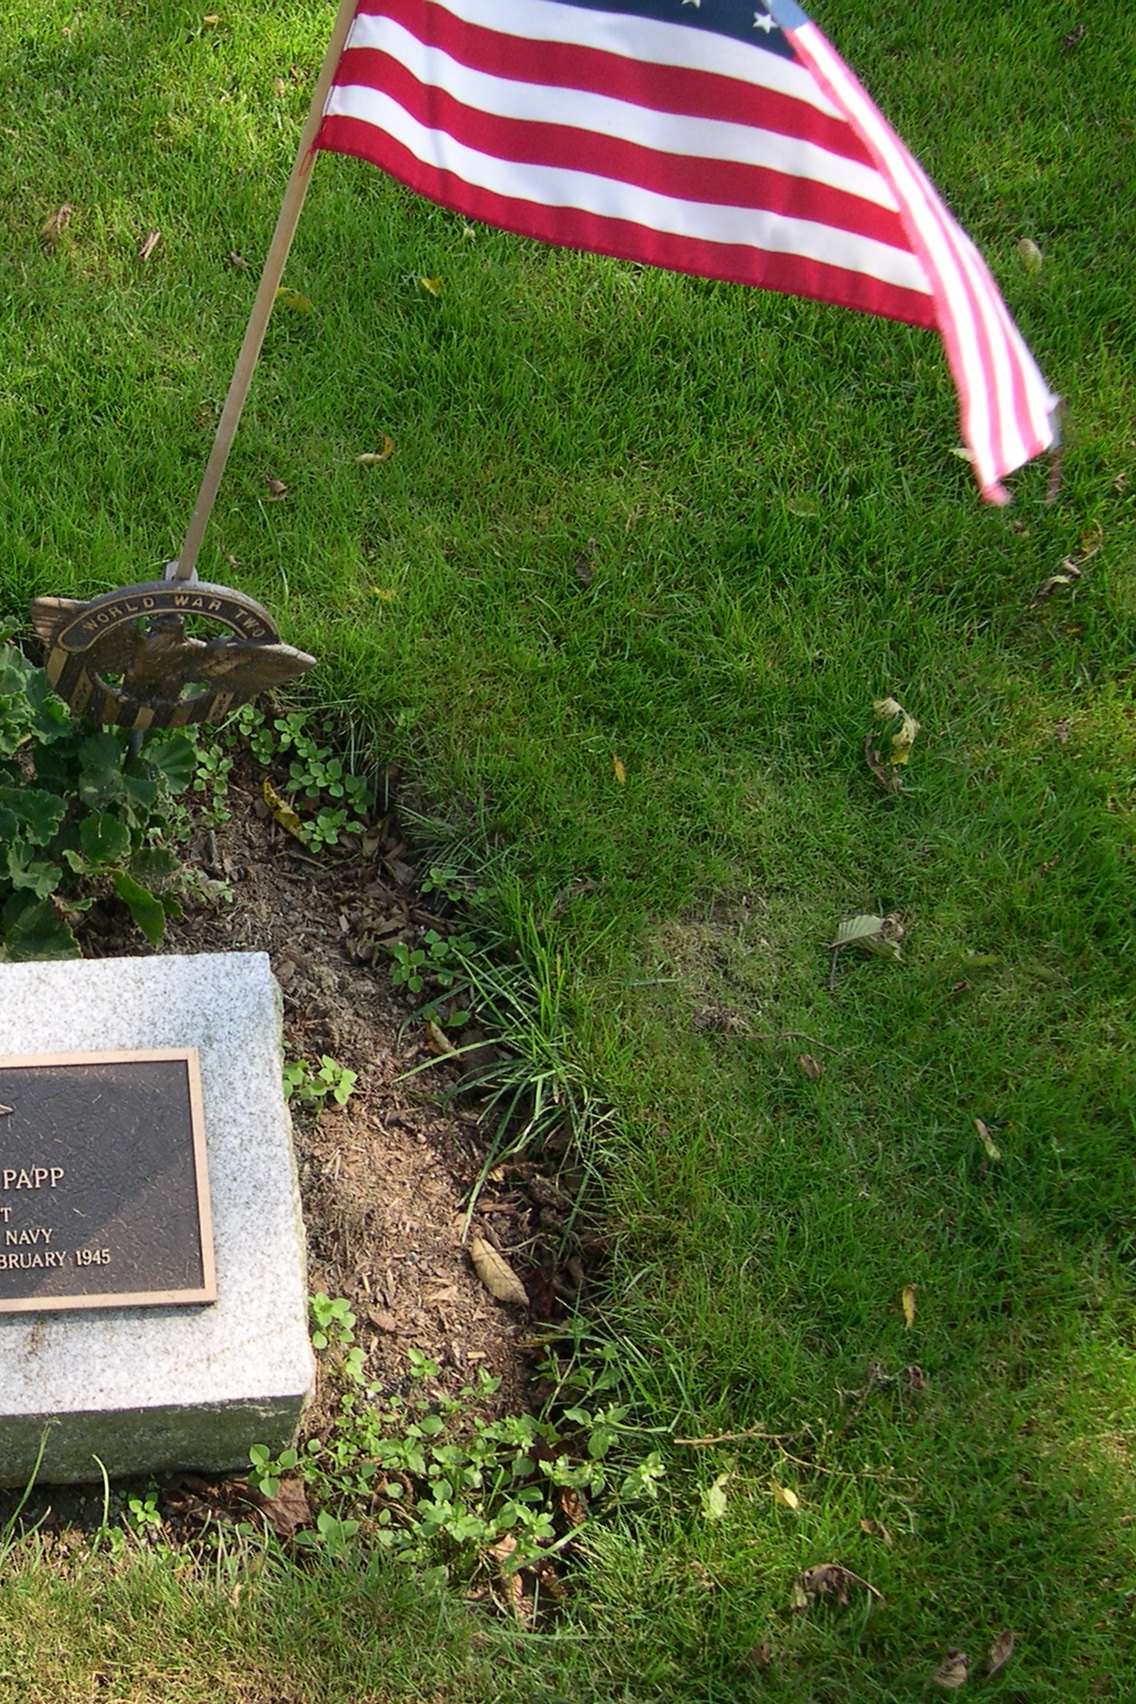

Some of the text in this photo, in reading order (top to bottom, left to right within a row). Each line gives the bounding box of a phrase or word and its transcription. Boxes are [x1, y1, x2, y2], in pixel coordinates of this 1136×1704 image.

[82, 595, 266, 638] WORLD WAR TWO
[2, 1166, 65, 1190] PAPP
[5, 1228, 53, 1246] NAVY
[76, 1248, 112, 1266] 1945
